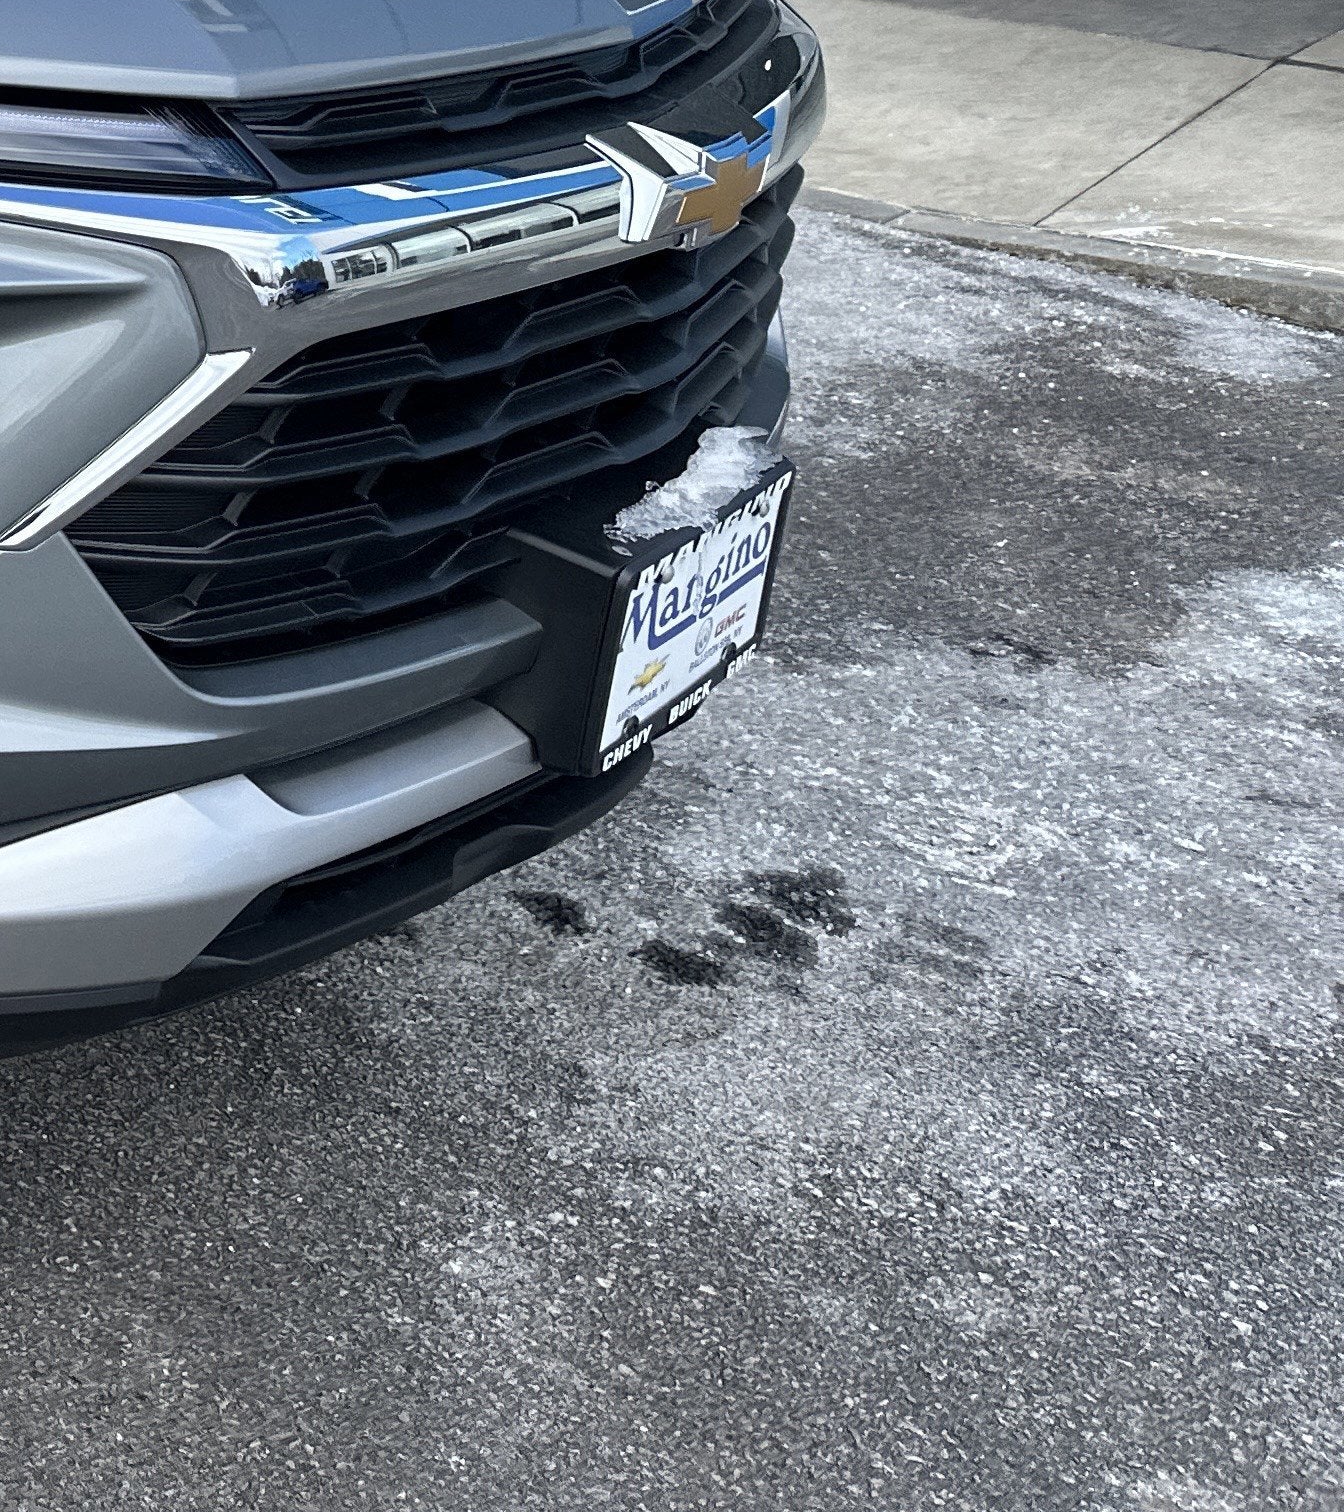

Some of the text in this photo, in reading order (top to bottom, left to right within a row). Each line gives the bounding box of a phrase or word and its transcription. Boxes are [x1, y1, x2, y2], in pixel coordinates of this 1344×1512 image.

[621, 521, 771, 650] Mangino
[714, 603, 747, 638] GMC
[602, 643, 757, 772] CHEVY BUICK GMC
